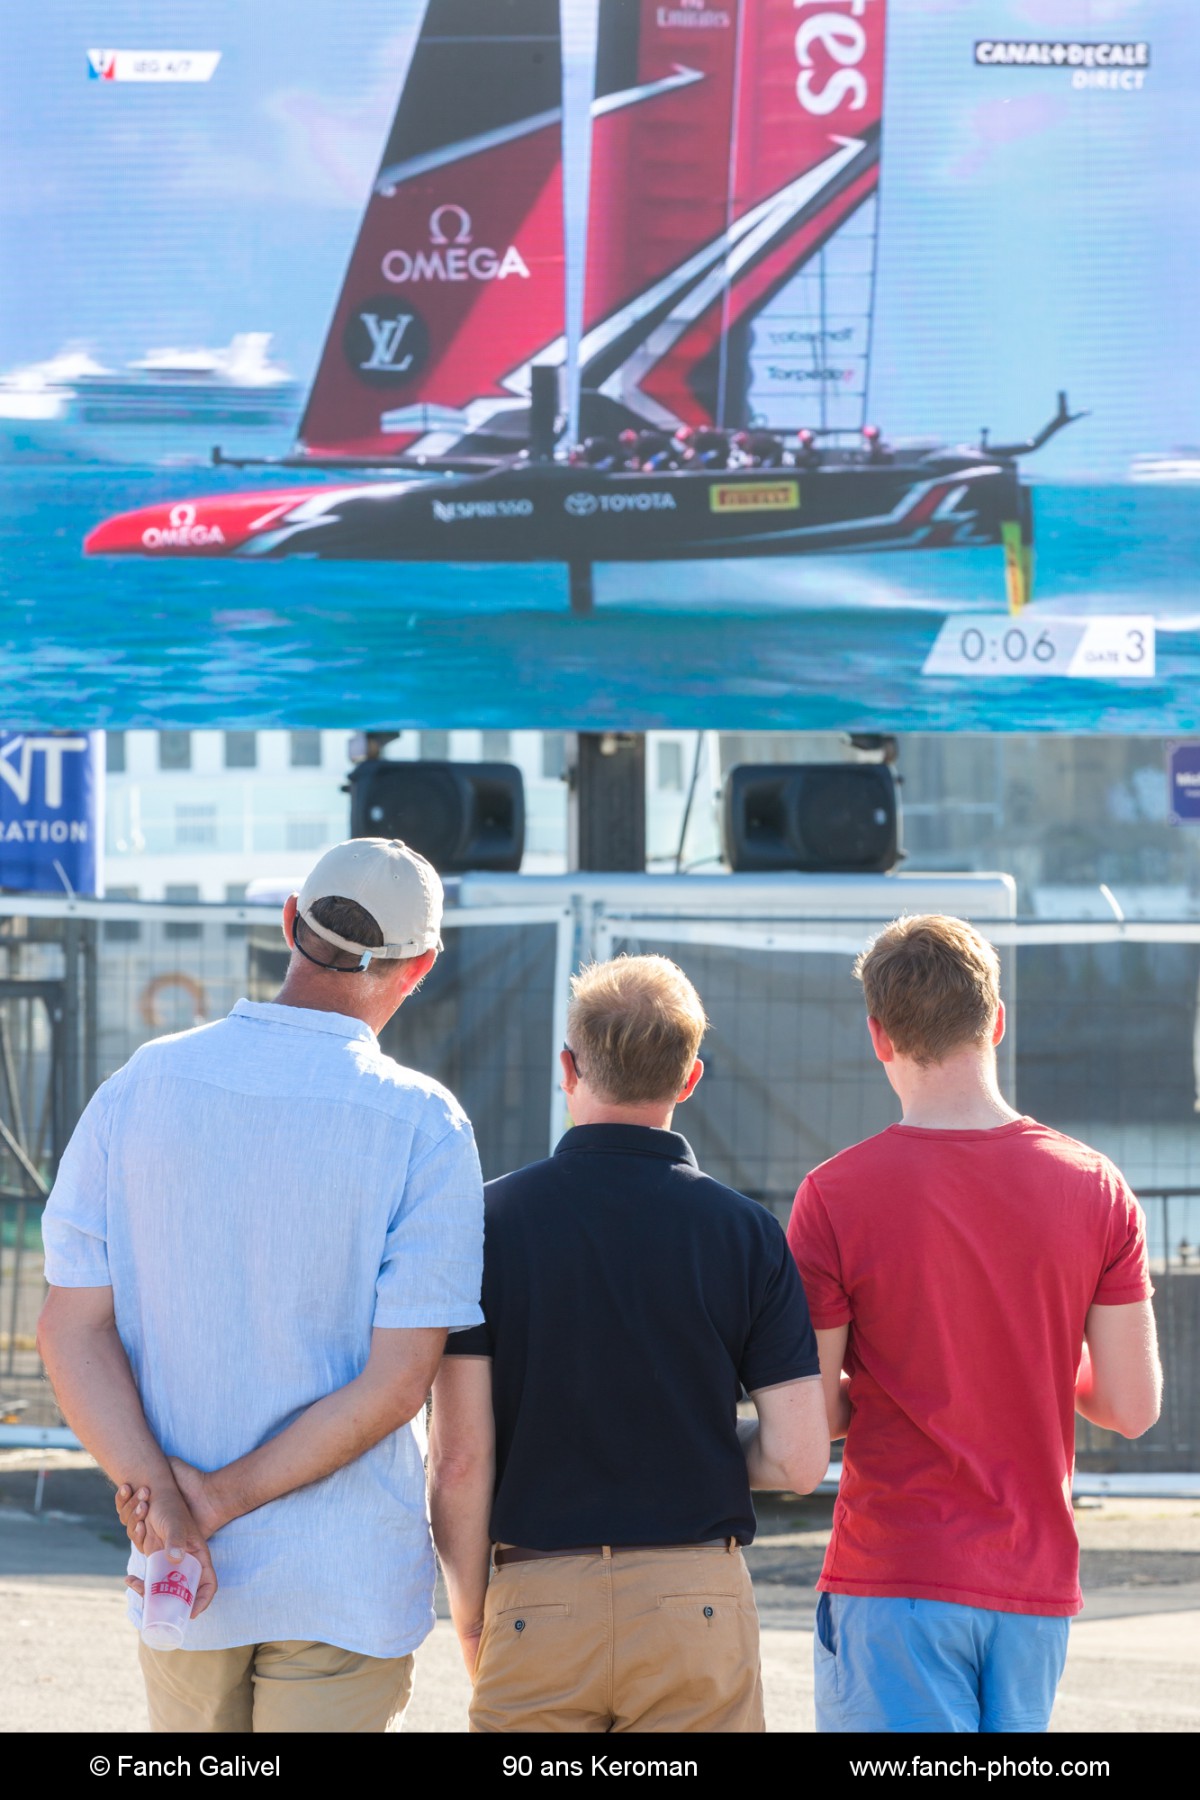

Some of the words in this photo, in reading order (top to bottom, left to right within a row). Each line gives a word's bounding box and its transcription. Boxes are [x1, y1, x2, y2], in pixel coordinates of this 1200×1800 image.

[1072, 70, 1145, 90] DIRECT
[381, 245, 531, 283] OMEGA
[600, 492, 676, 512] TOYOTA
[142, 524, 226, 549] OMEGA
[960, 628, 1056, 662] 0:06
[1125, 629, 1146, 663] 3
